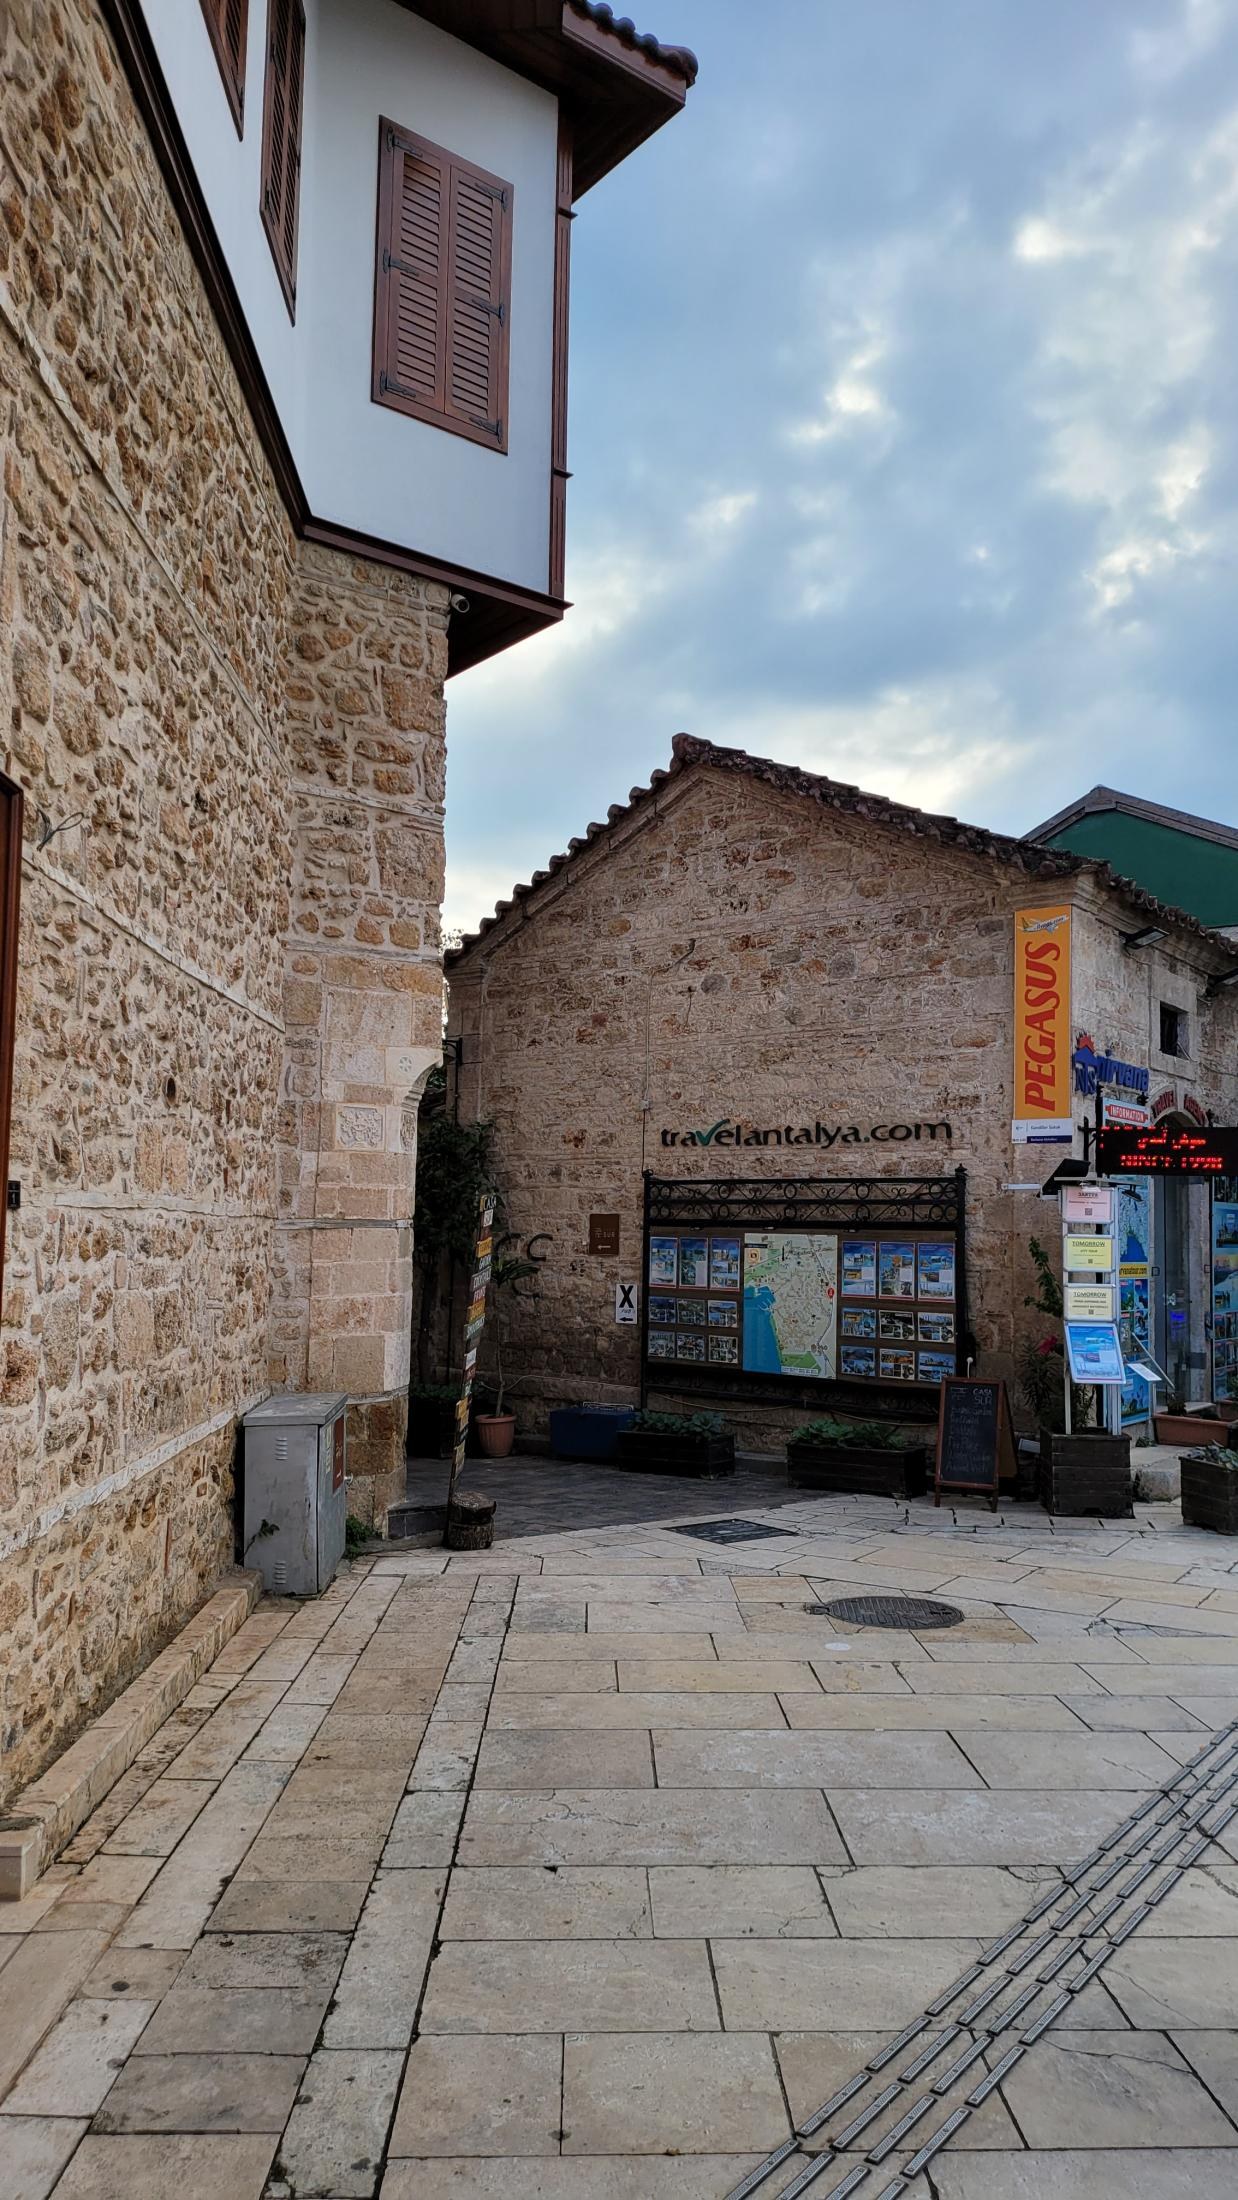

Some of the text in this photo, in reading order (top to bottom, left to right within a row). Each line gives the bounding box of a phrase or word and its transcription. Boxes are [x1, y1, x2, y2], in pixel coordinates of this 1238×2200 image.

[1024, 941, 1060, 1112] PEGASUS
[1096, 1049, 1149, 1092] nirvana
[1110, 1105, 1145, 1122] INFORMATION
[660, 1118, 953, 1149] travelantalya.com
[619, 1285, 634, 1308] X
[972, 1388, 993, 1396] CASA
